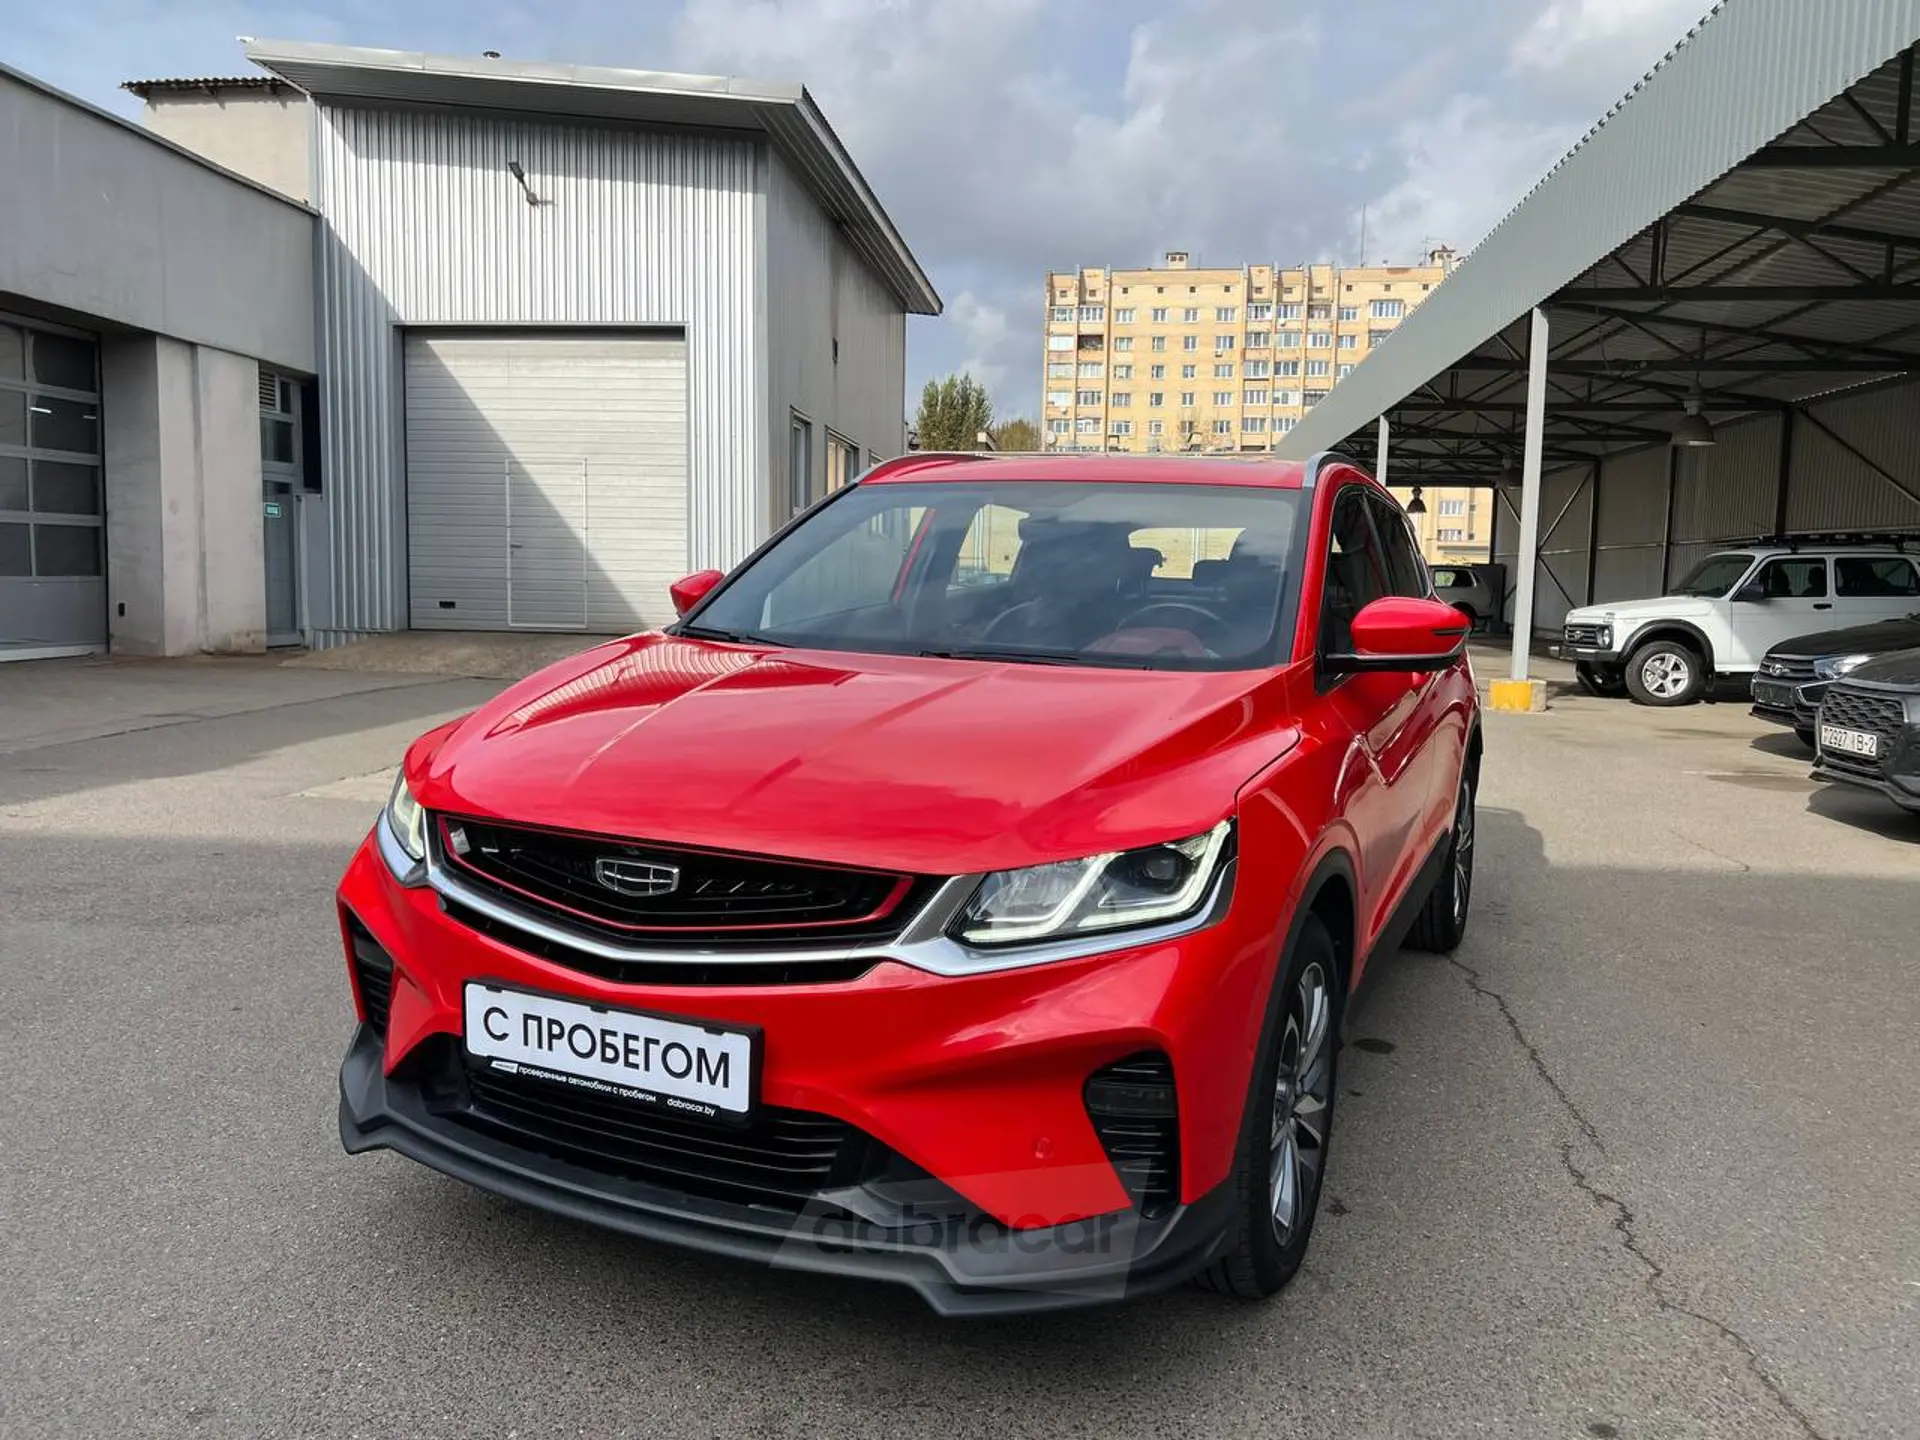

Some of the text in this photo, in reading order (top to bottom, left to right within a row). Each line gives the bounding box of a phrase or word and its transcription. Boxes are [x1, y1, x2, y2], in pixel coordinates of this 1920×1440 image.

[482, 1006, 730, 1089] С ПРОБЕГОМ
[518, 1066, 567, 1082] проверенные
[567, 1076, 612, 1093] автомобили
[619, 1087, 657, 1102] пробегом
